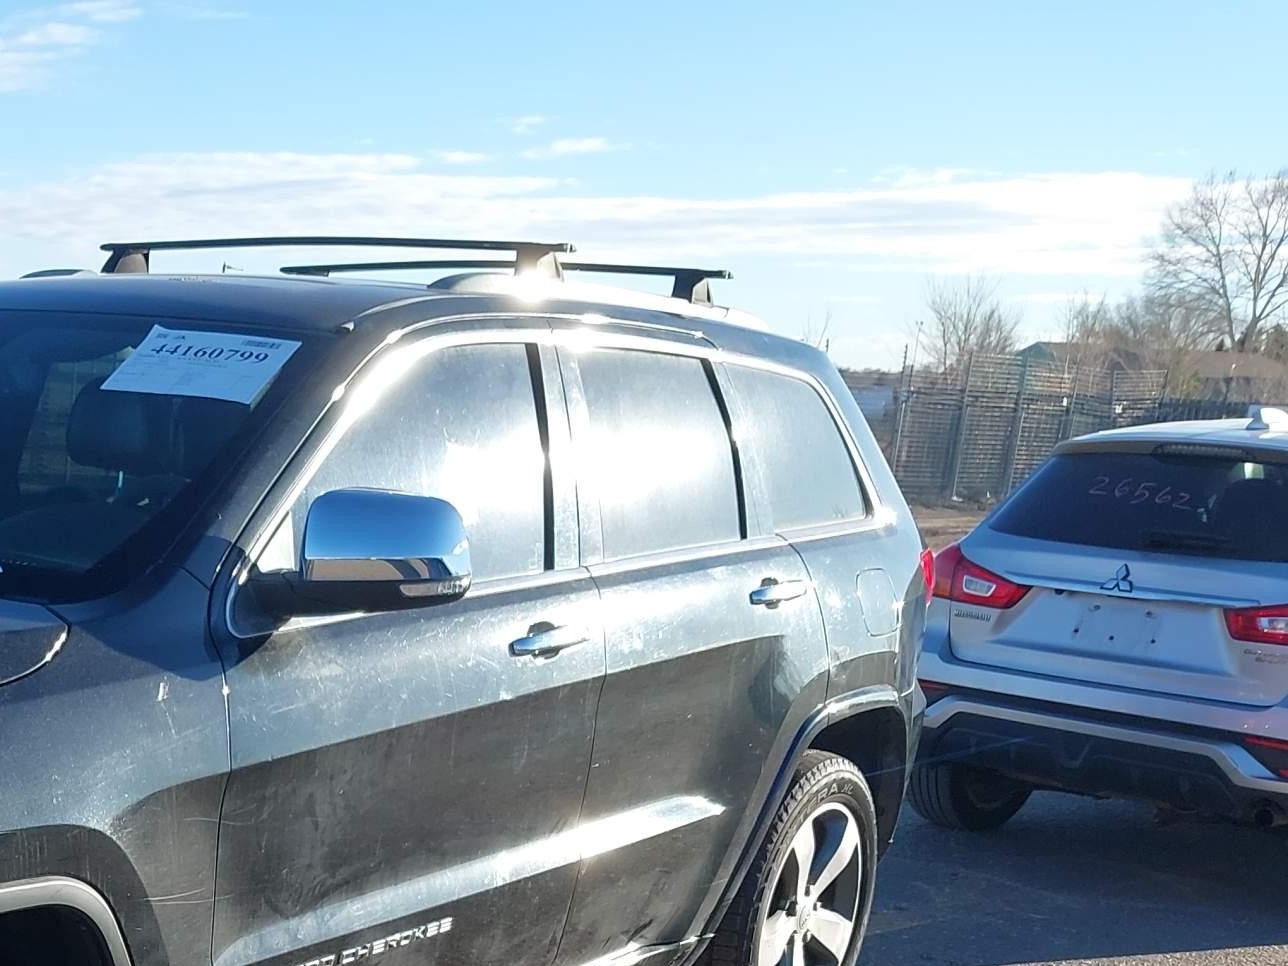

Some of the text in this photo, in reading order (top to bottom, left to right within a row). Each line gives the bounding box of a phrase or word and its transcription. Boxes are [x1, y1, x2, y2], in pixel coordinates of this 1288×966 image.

[150, 343, 270, 364] 44160799
[1088, 475, 1192, 511] 26562
[338, 916, 454, 965] CHEROKEE
